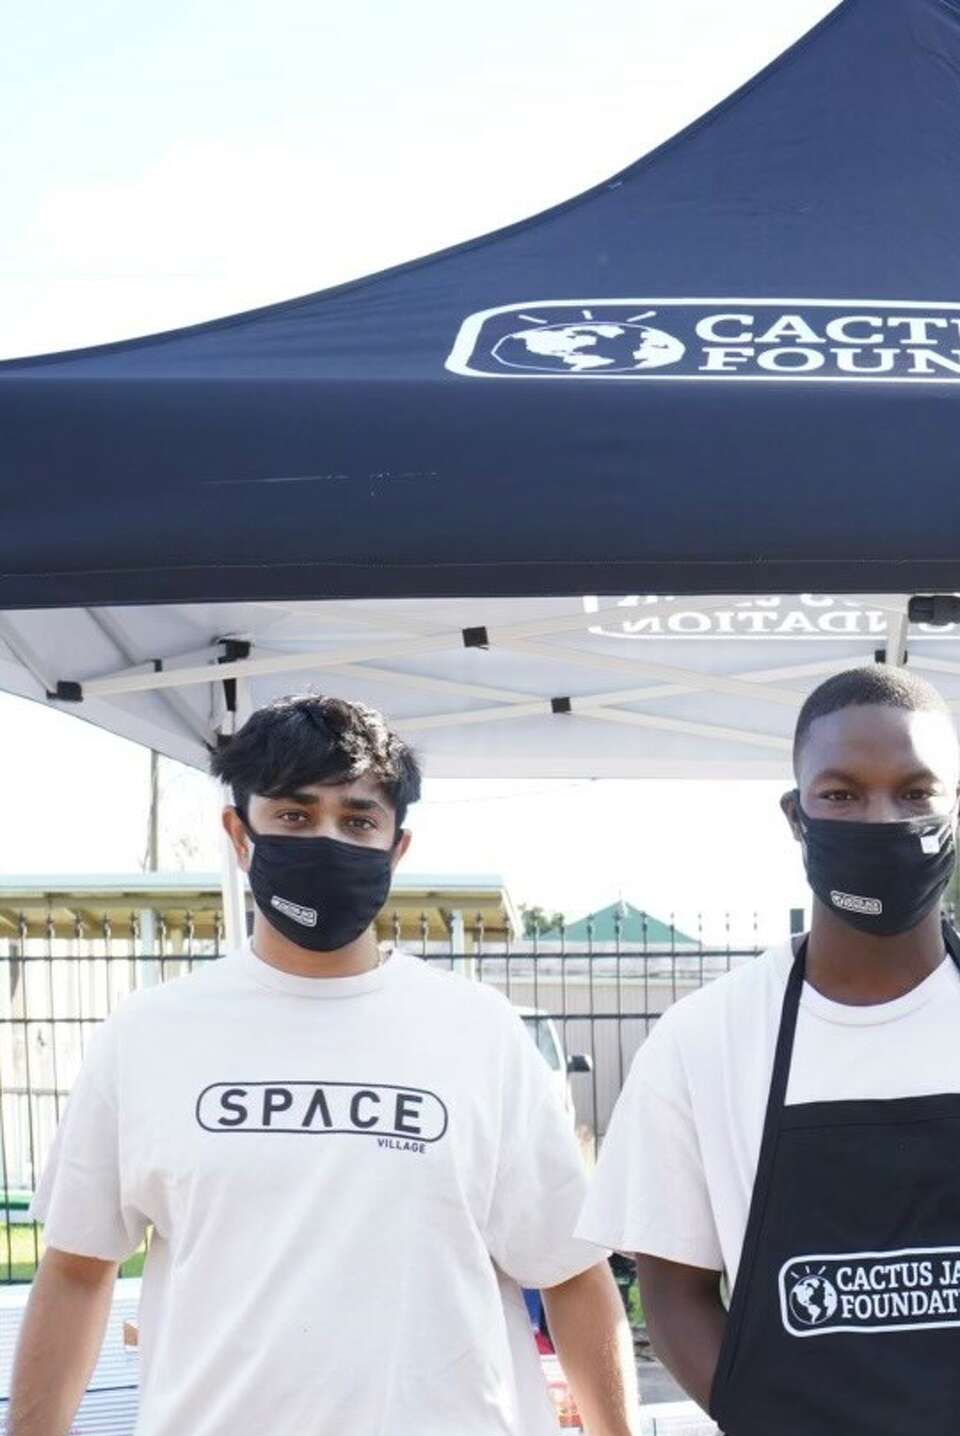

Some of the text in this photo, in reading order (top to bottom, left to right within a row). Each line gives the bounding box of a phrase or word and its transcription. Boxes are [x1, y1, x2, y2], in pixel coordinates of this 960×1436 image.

[217, 1087, 424, 1135] SPACE
[377, 1137, 427, 1154] VILLAGE
[836, 1262, 933, 1292] CACTUS
